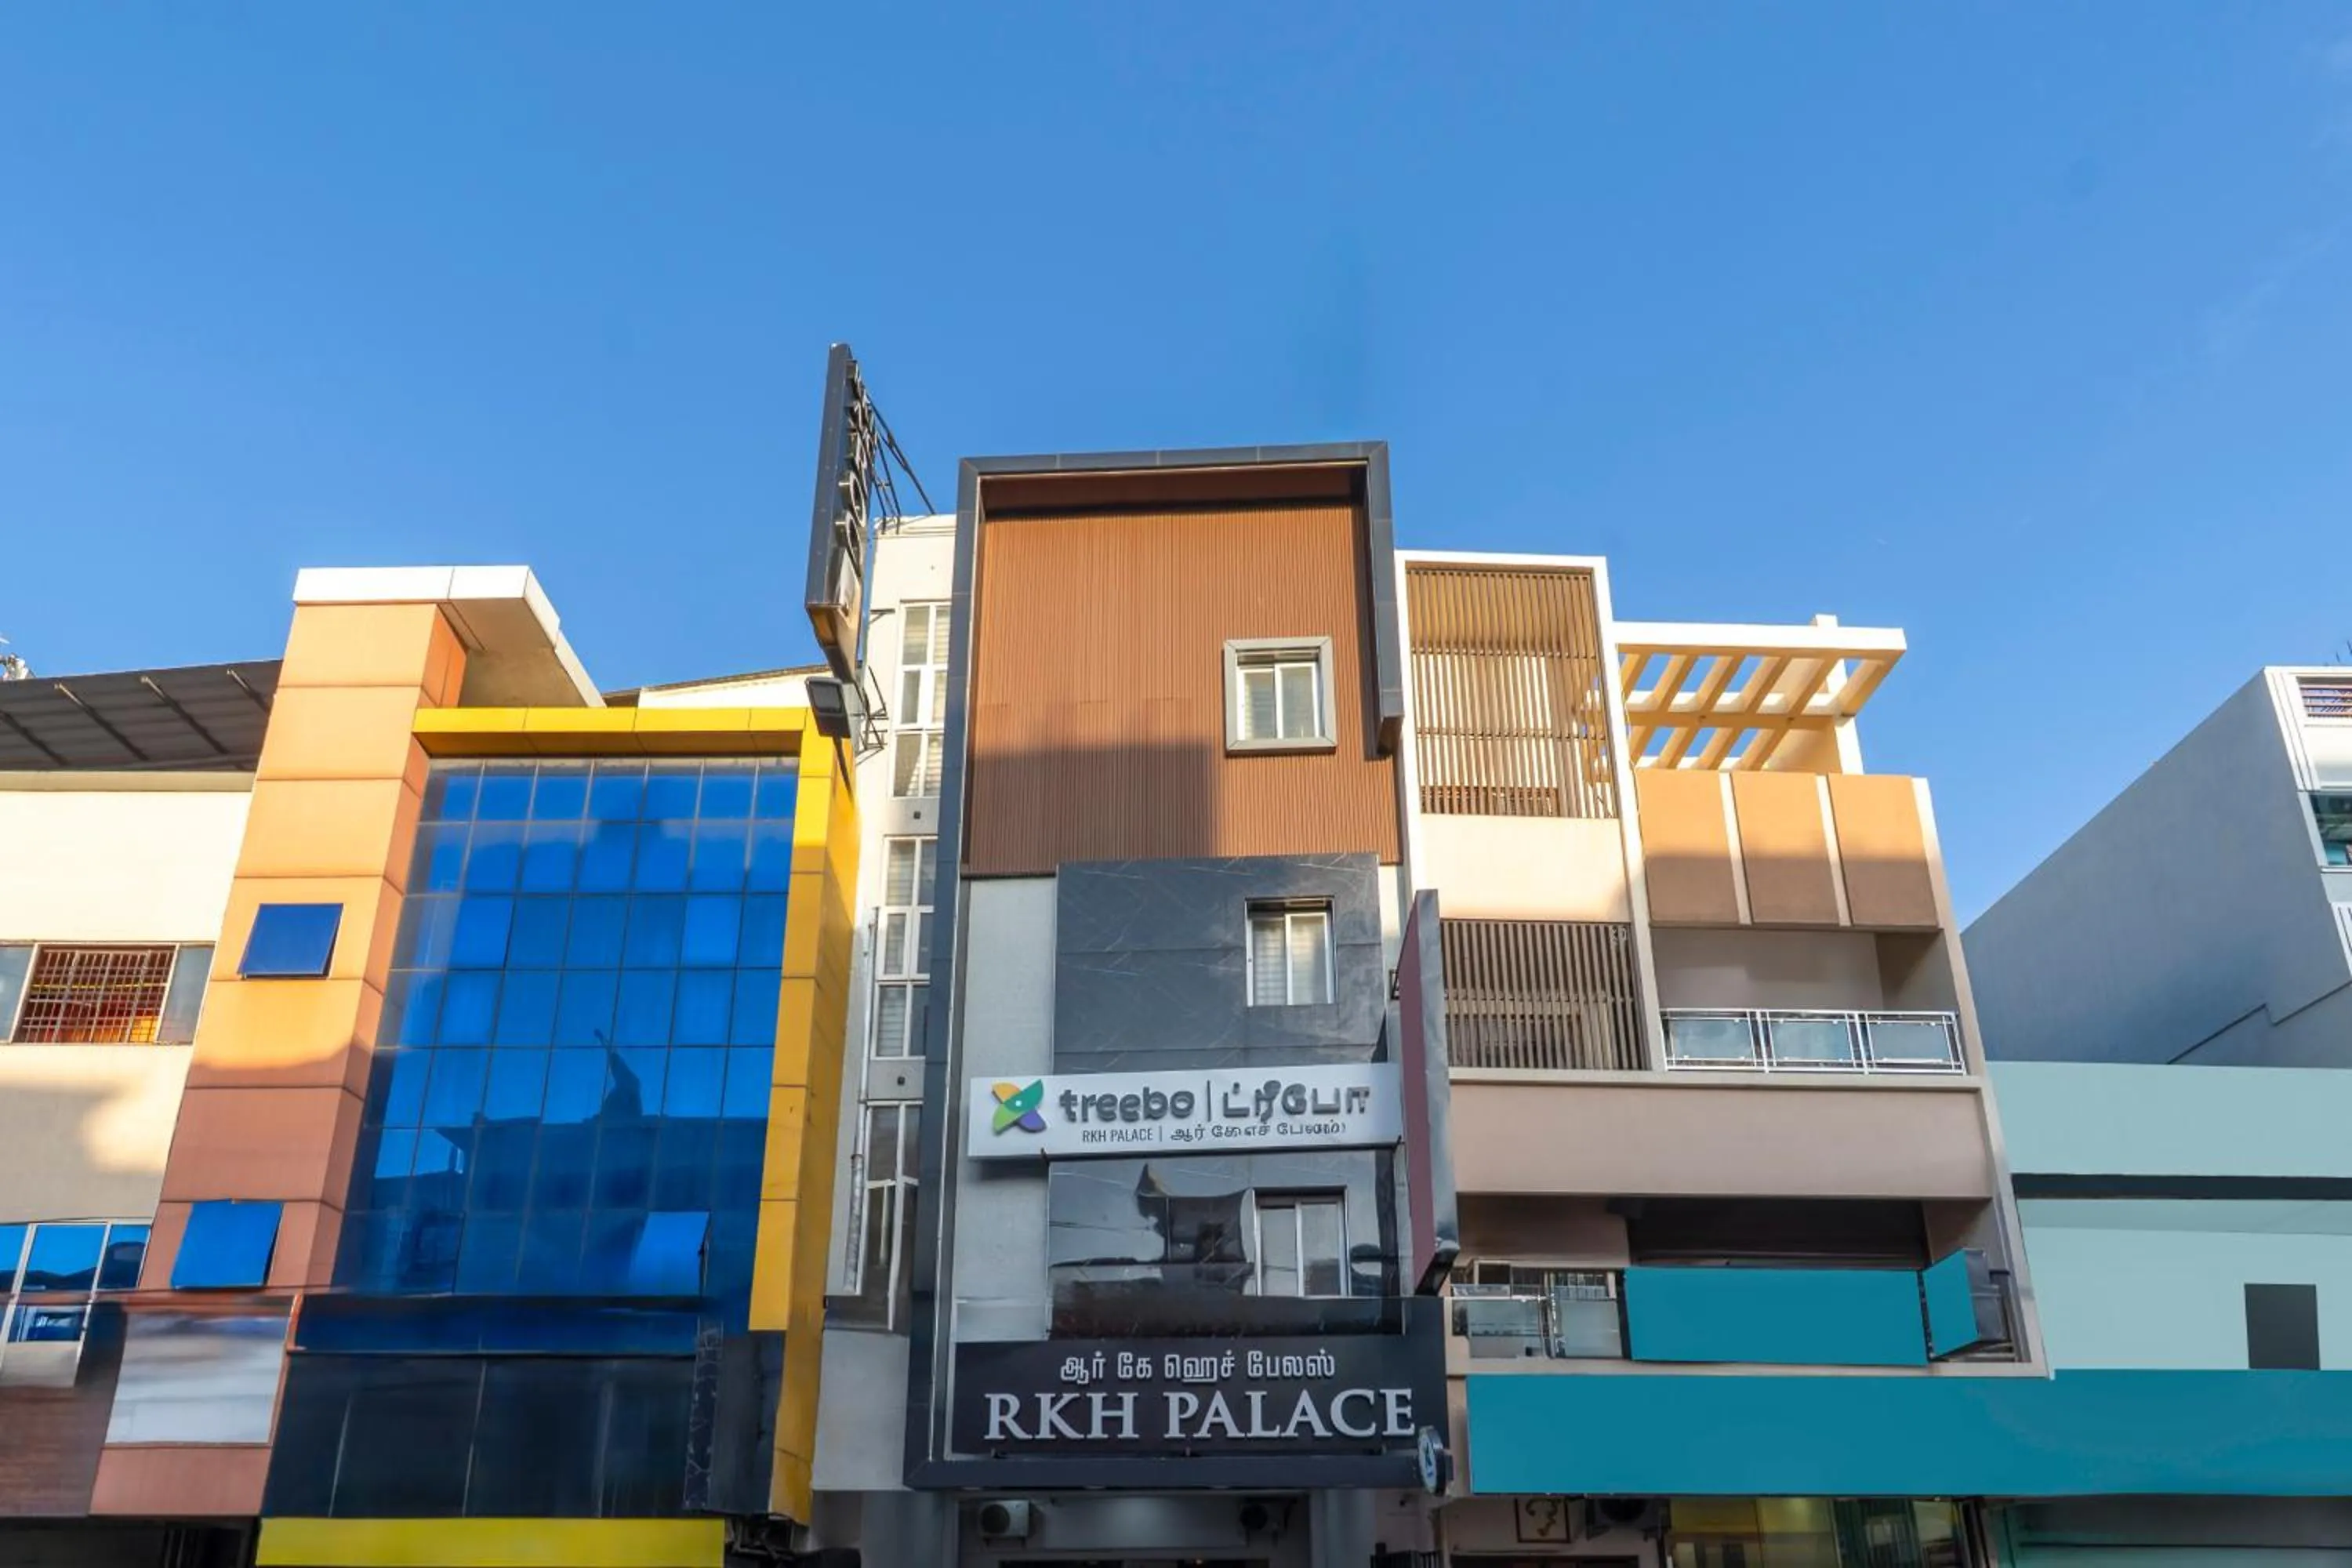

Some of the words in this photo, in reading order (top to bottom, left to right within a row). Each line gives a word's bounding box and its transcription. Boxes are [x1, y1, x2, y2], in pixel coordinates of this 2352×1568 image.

[1060, 1087, 1195, 1123] treebo
[1083, 1129, 1107, 1142] RKH
[1110, 1127, 1153, 1142] PALACE
[1061, 1350, 1106, 1385] ஆர்
[1117, 1352, 1152, 1379] கே
[1247, 1348, 1336, 1378] பேலஸ்
[983, 1392, 1140, 1440] RKH
[1163, 1388, 1416, 1439] PALACE
